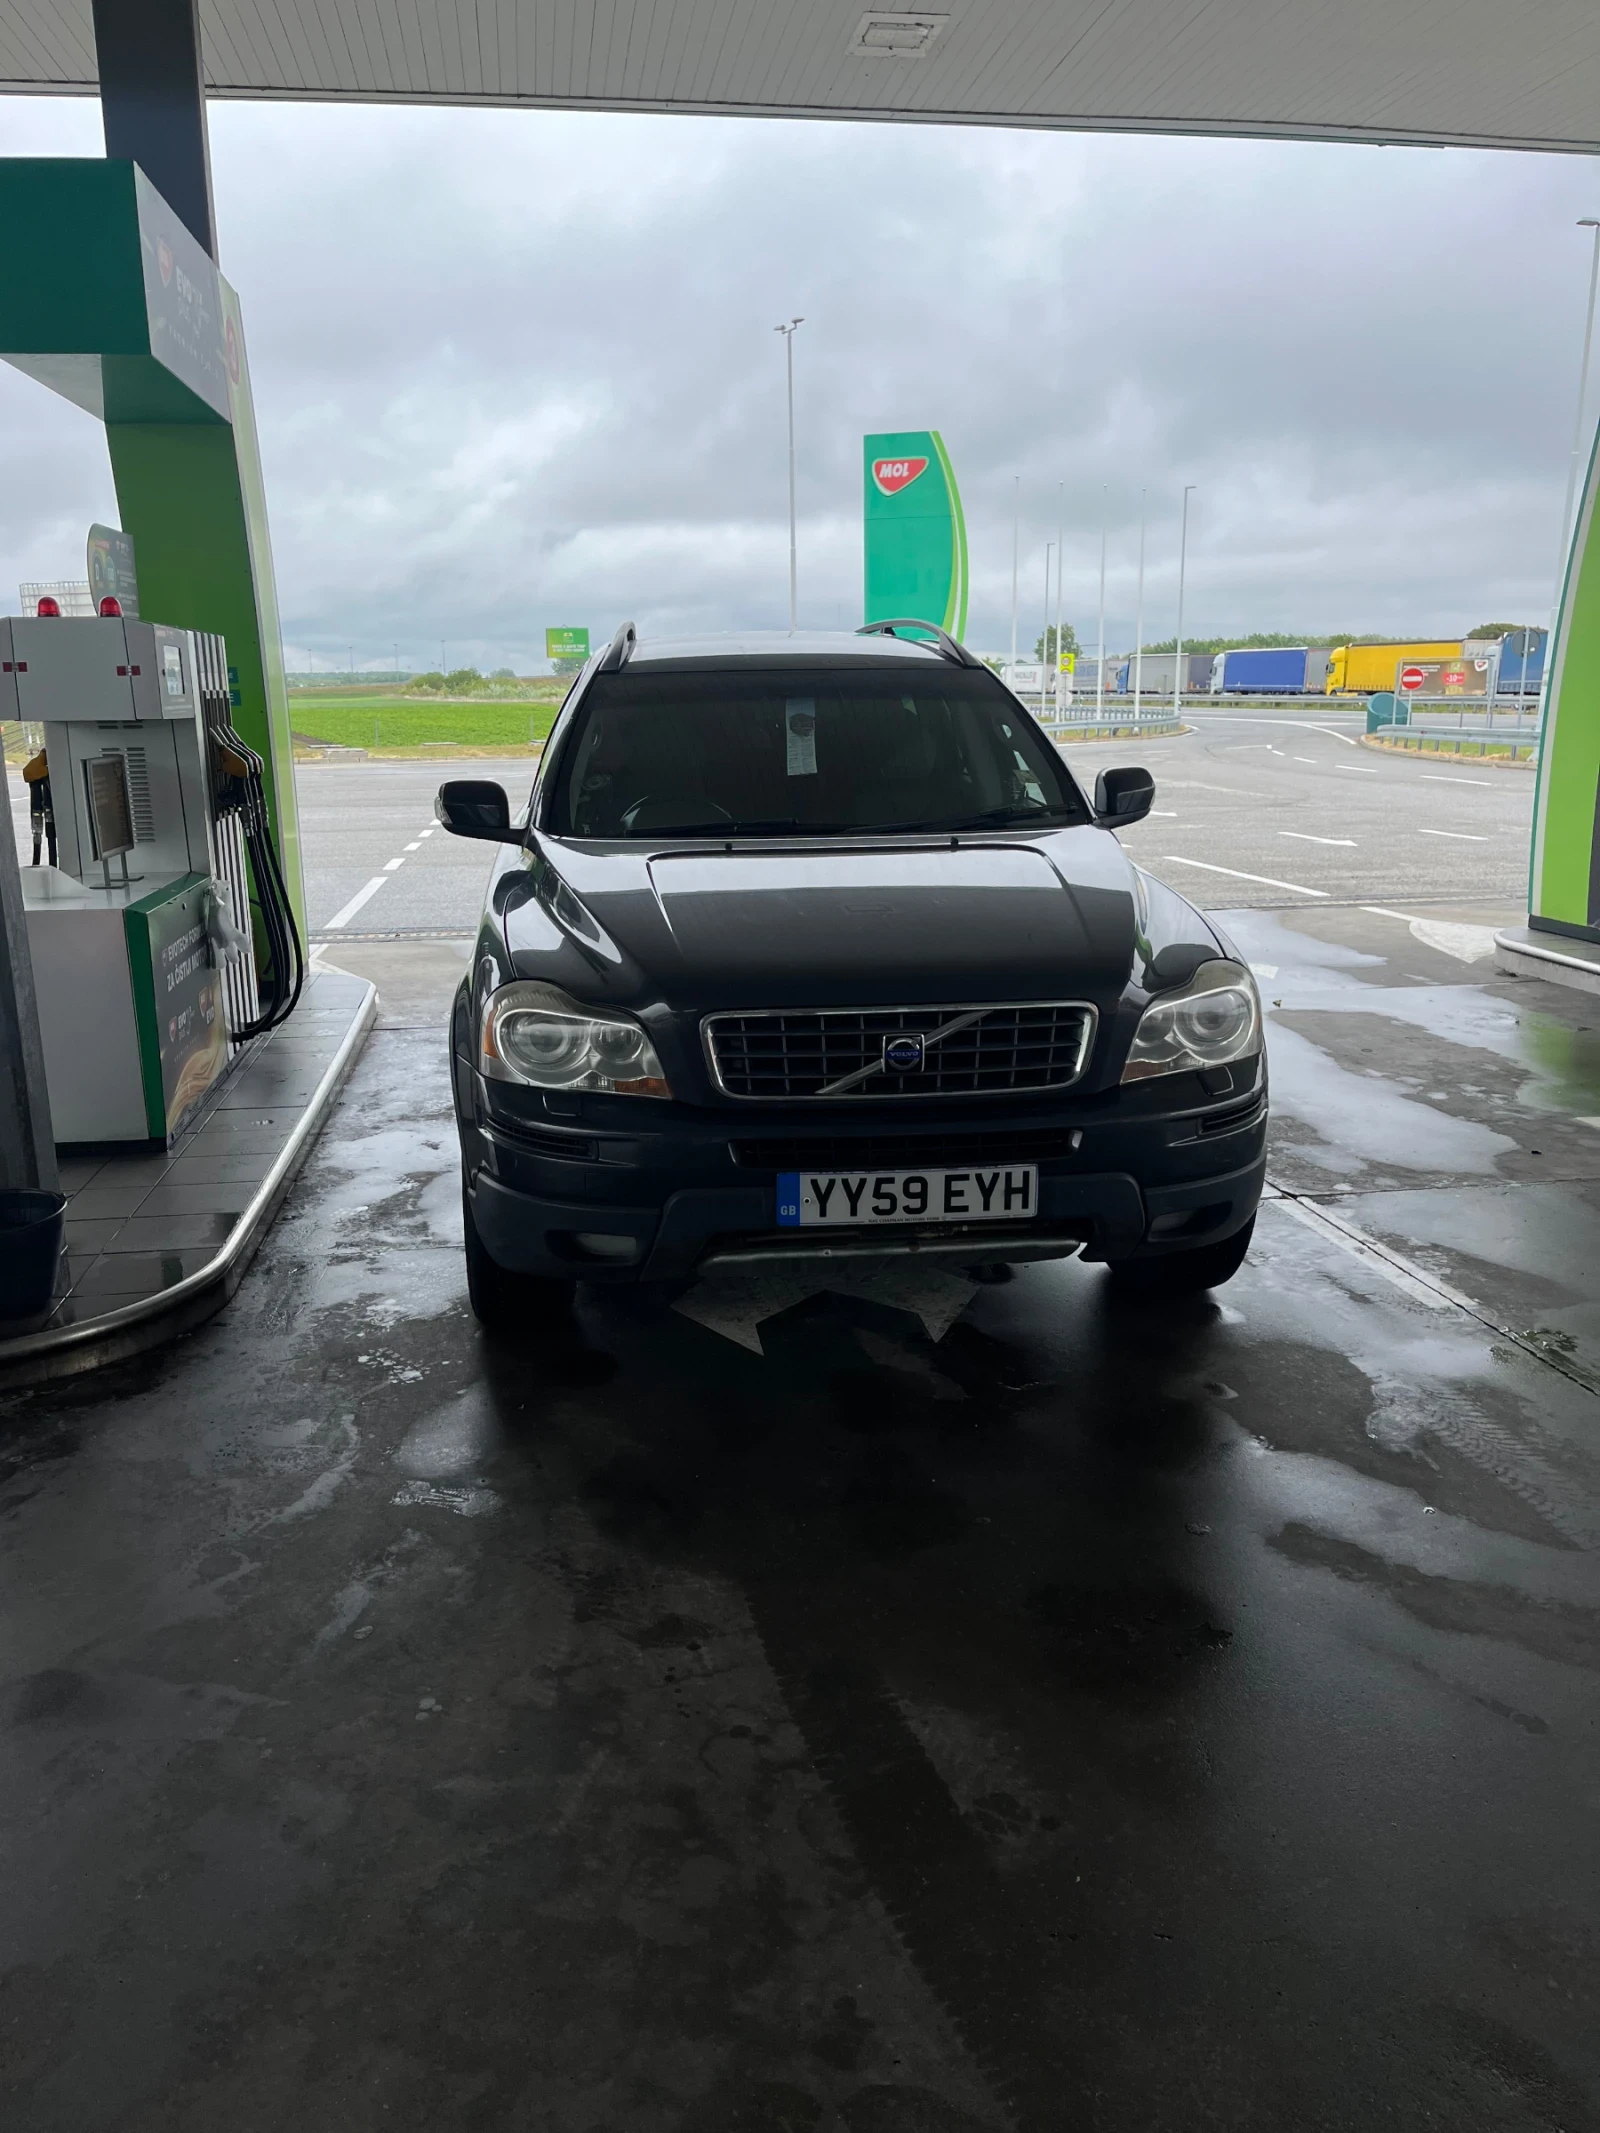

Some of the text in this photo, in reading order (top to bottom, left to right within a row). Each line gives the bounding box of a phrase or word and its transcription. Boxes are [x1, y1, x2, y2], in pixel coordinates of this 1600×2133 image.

[879, 462, 909, 478] MOL
[810, 1169, 1031, 1218] YY59 EYH
[780, 1205, 797, 1216] GB
